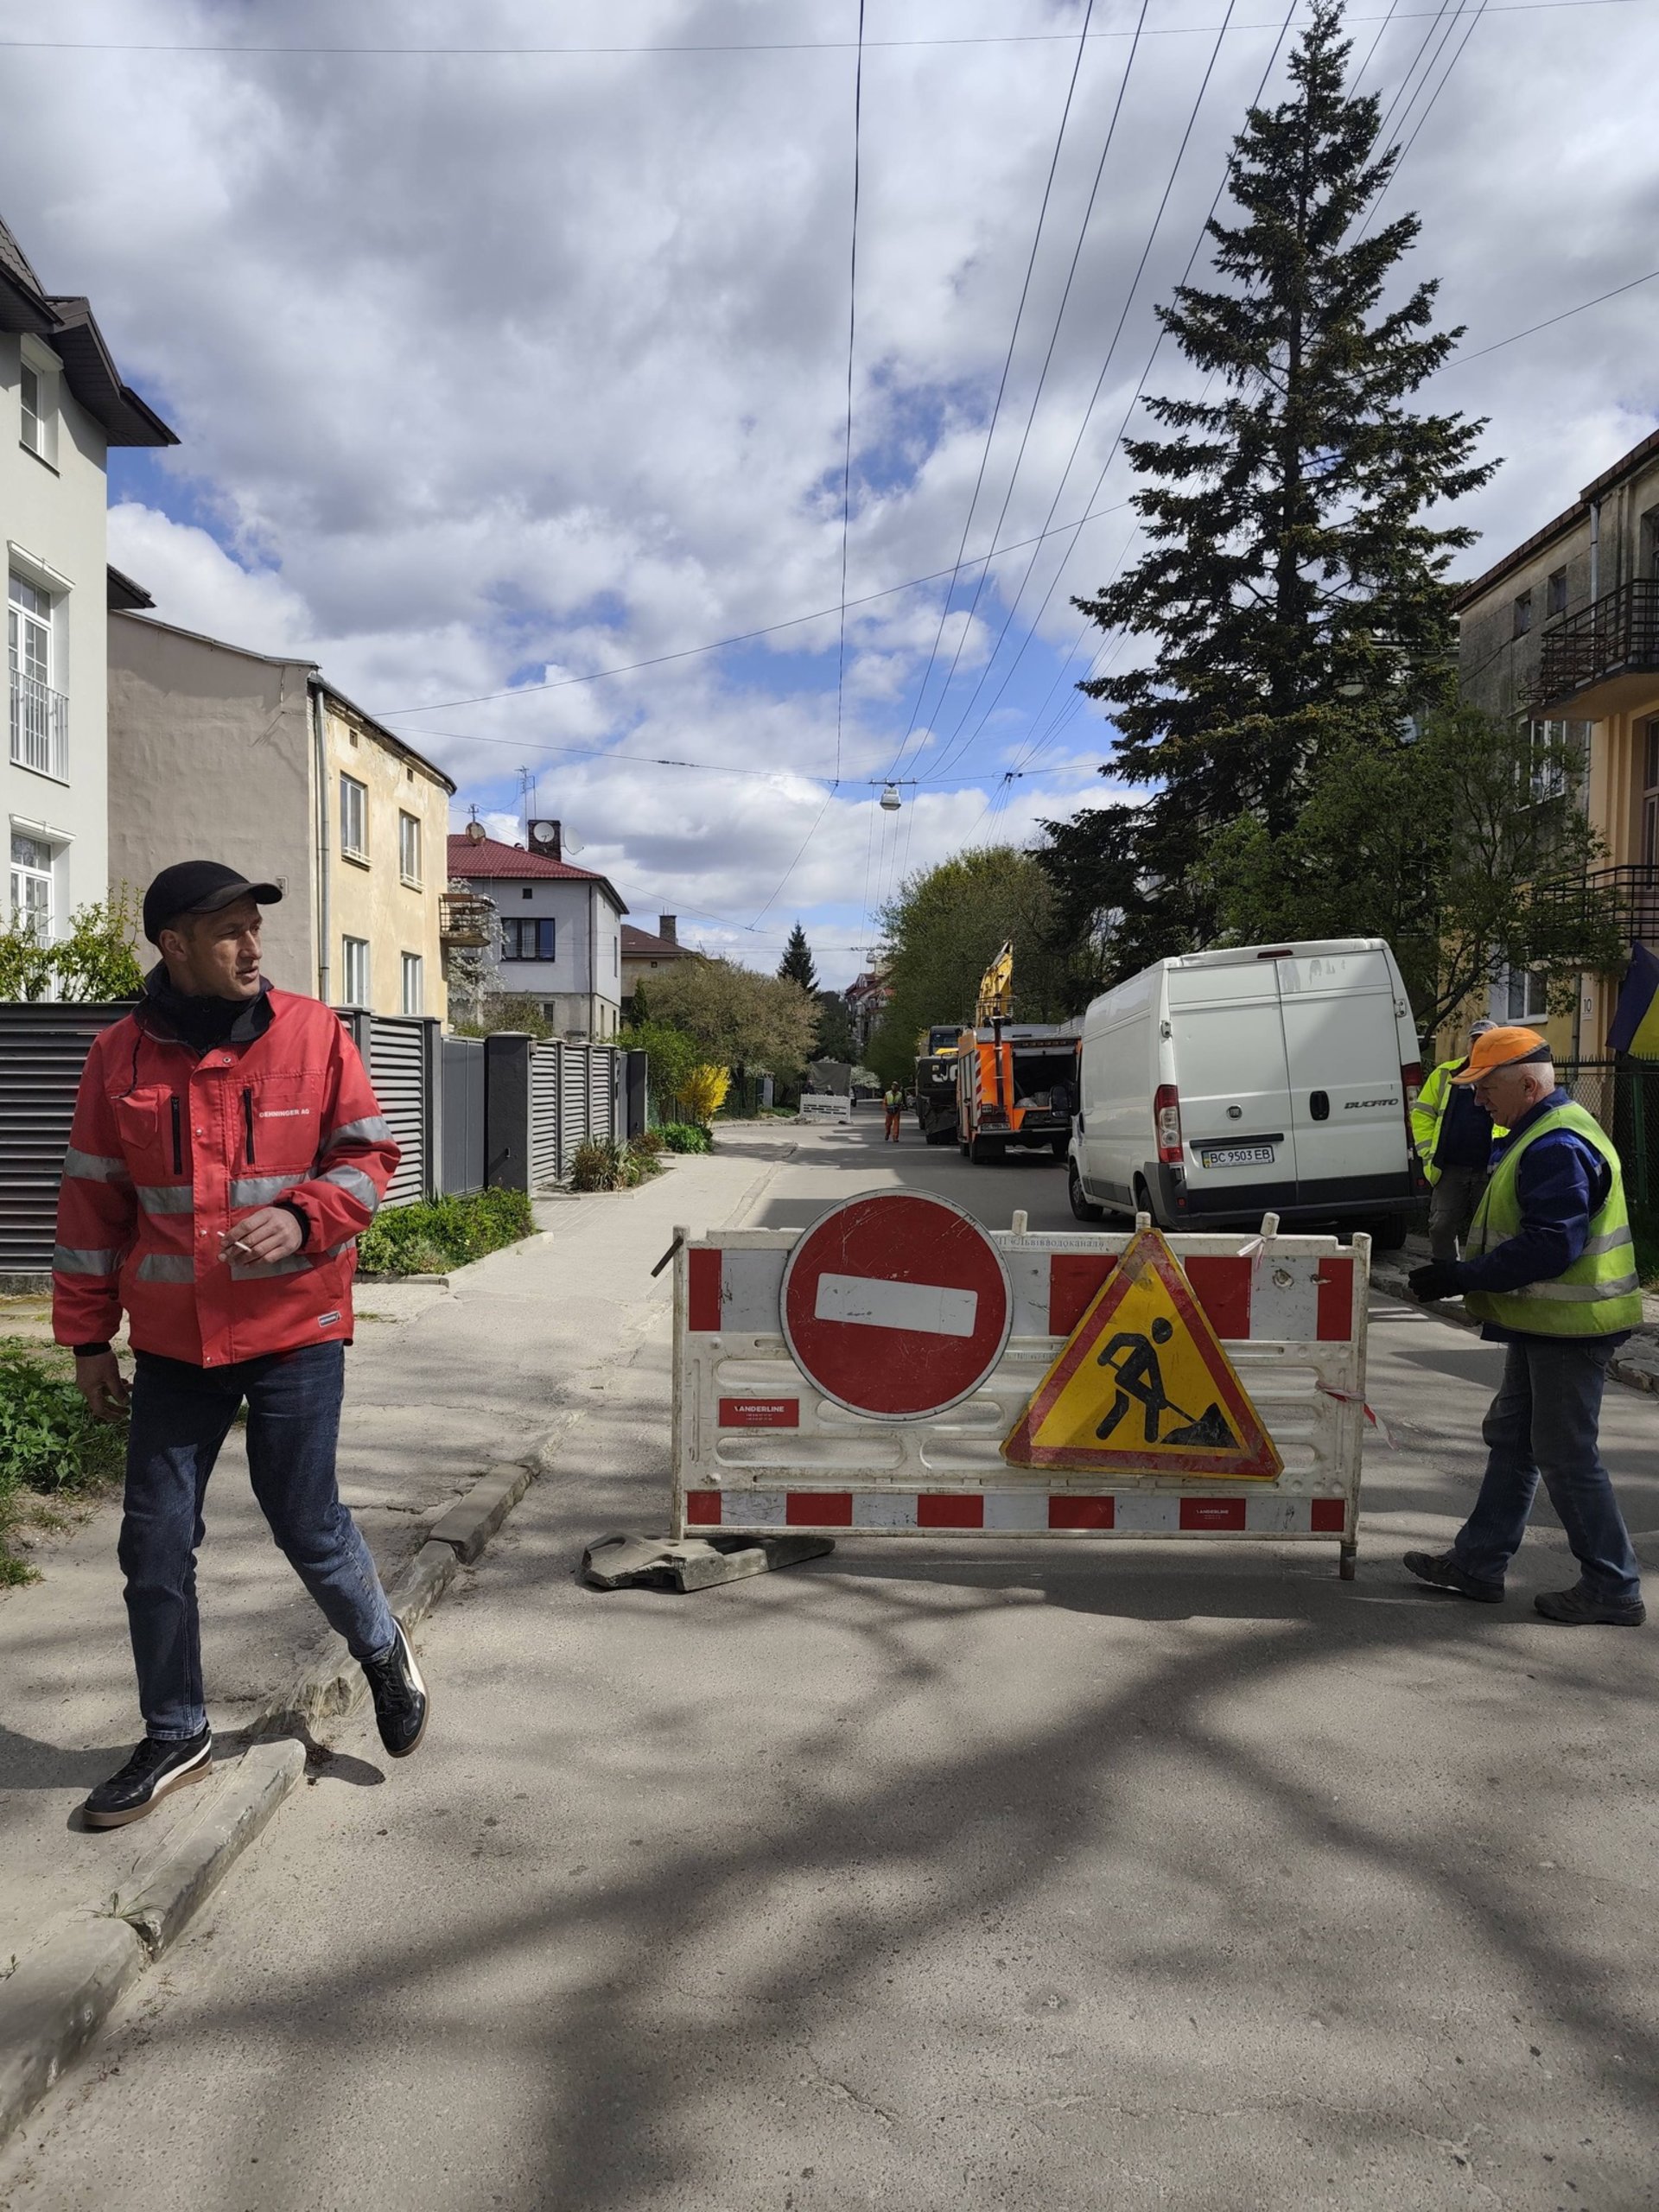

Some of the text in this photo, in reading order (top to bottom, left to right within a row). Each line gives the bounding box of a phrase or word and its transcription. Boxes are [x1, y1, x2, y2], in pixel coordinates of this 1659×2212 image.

[1583, 998, 1592, 1012] 10
[931, 1065, 958, 1082] JC
[1344, 1098, 1399, 1109] DUCATO
[1210, 1153, 1226, 1164] BC
[1227, 1150, 1253, 1162] 9503
[1254, 1148, 1271, 1160] EB
